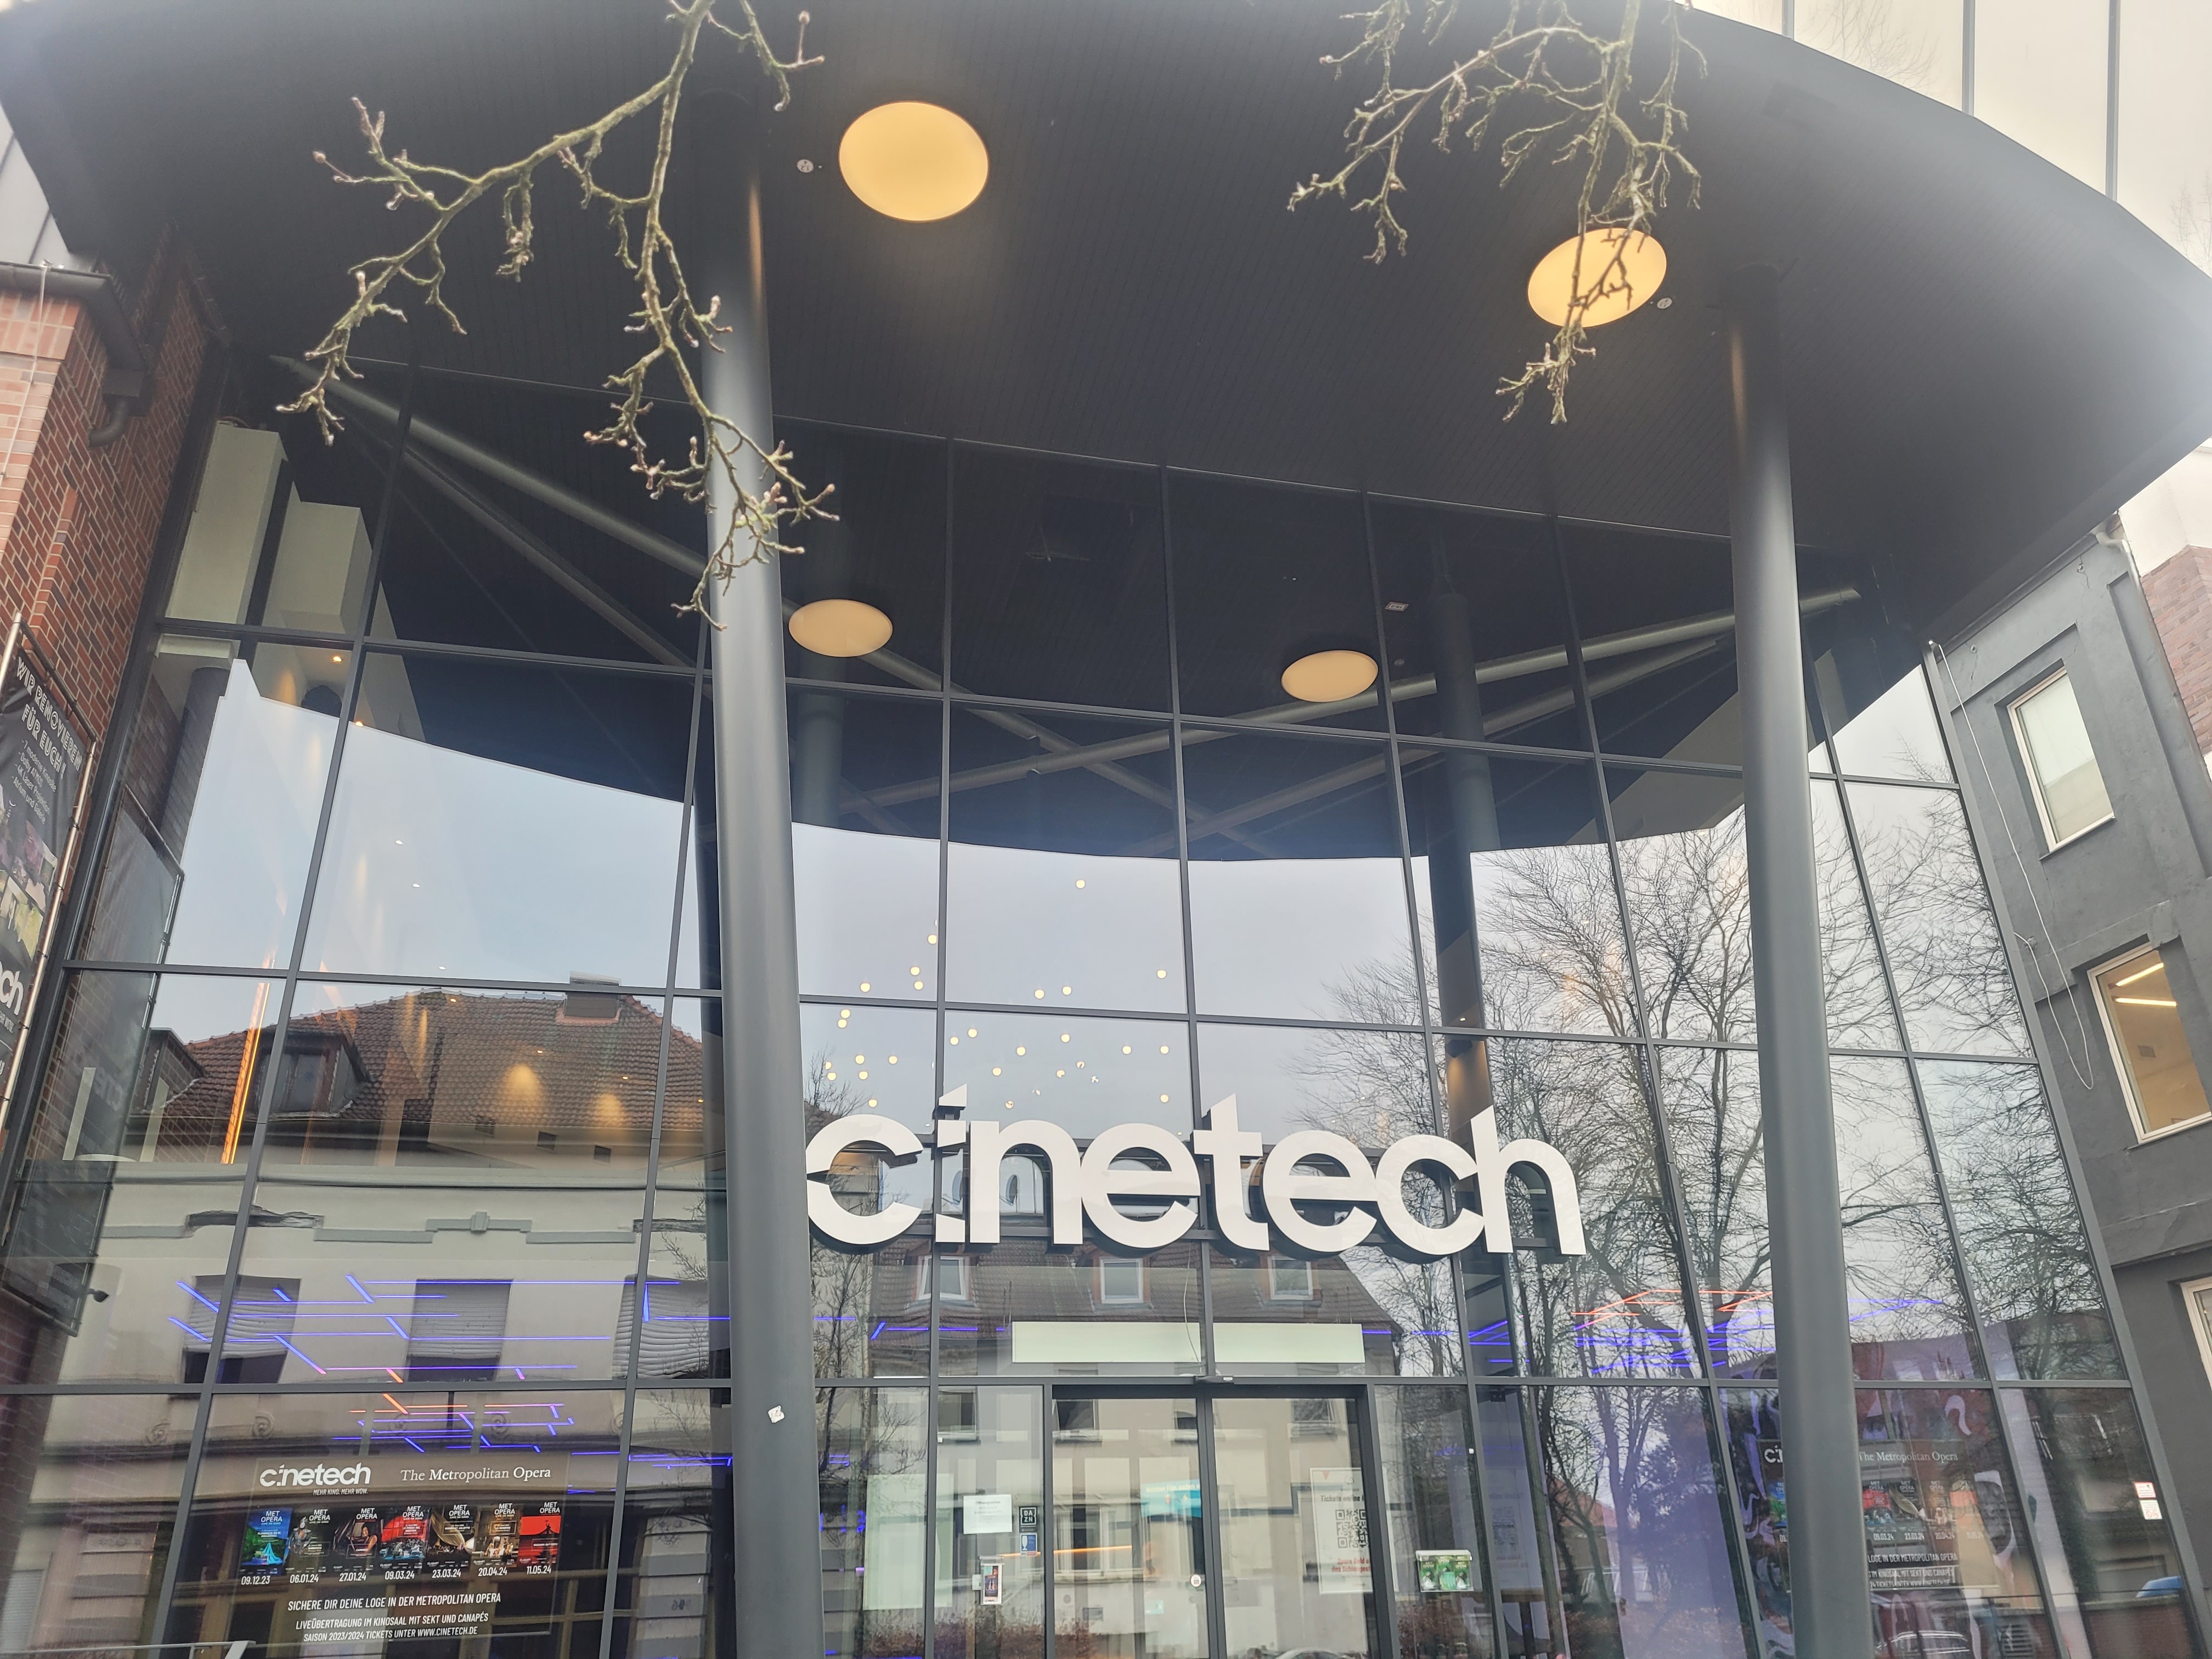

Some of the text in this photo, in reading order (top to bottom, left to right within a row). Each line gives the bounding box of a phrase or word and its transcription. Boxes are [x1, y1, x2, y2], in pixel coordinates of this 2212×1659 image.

[17, 657, 82, 771] WIR RENOVIEREN
[22, 703, 41, 740] FÜR
[20, 752, 31, 773] Dolby
[31, 766, 43, 787] ATMOS
[26, 747, 43, 772] moderne
[13, 776, 26, 799] Atrium
[26, 793, 34, 808] und
[22, 771, 34, 791] Laser
[806, 1084, 1586, 1256] cinetech
[1876, 1452, 1931, 1463] Metropolitan
[1932, 1451, 1958, 1463] Opera
[259, 1462, 551, 1487] cinetech The Metropolitan Opera
[1889, 1554, 1901, 1562] DER
[1901, 1553, 1939, 1562] METROPOLITAN
[1940, 1552, 1958, 1561] OPERA
[241, 1565, 552, 1585] 09.12.23 06.01.24 27.01.24 09.03.24 23.03.24 20.04.24 11.05.24
[288, 1593, 501, 1611] SICHERE DIR DEINE LOGE IN DER METROPOLITAN OPERA
[296, 1611, 489, 1630] LIVEÜBERTRAGUNG IM KINOSAAL MIT SEKT UND CANAPÉS
[303, 1626, 478, 1642] SAISON 2023/2024 TICKETS UNTER WWW.CINETECH.DE
